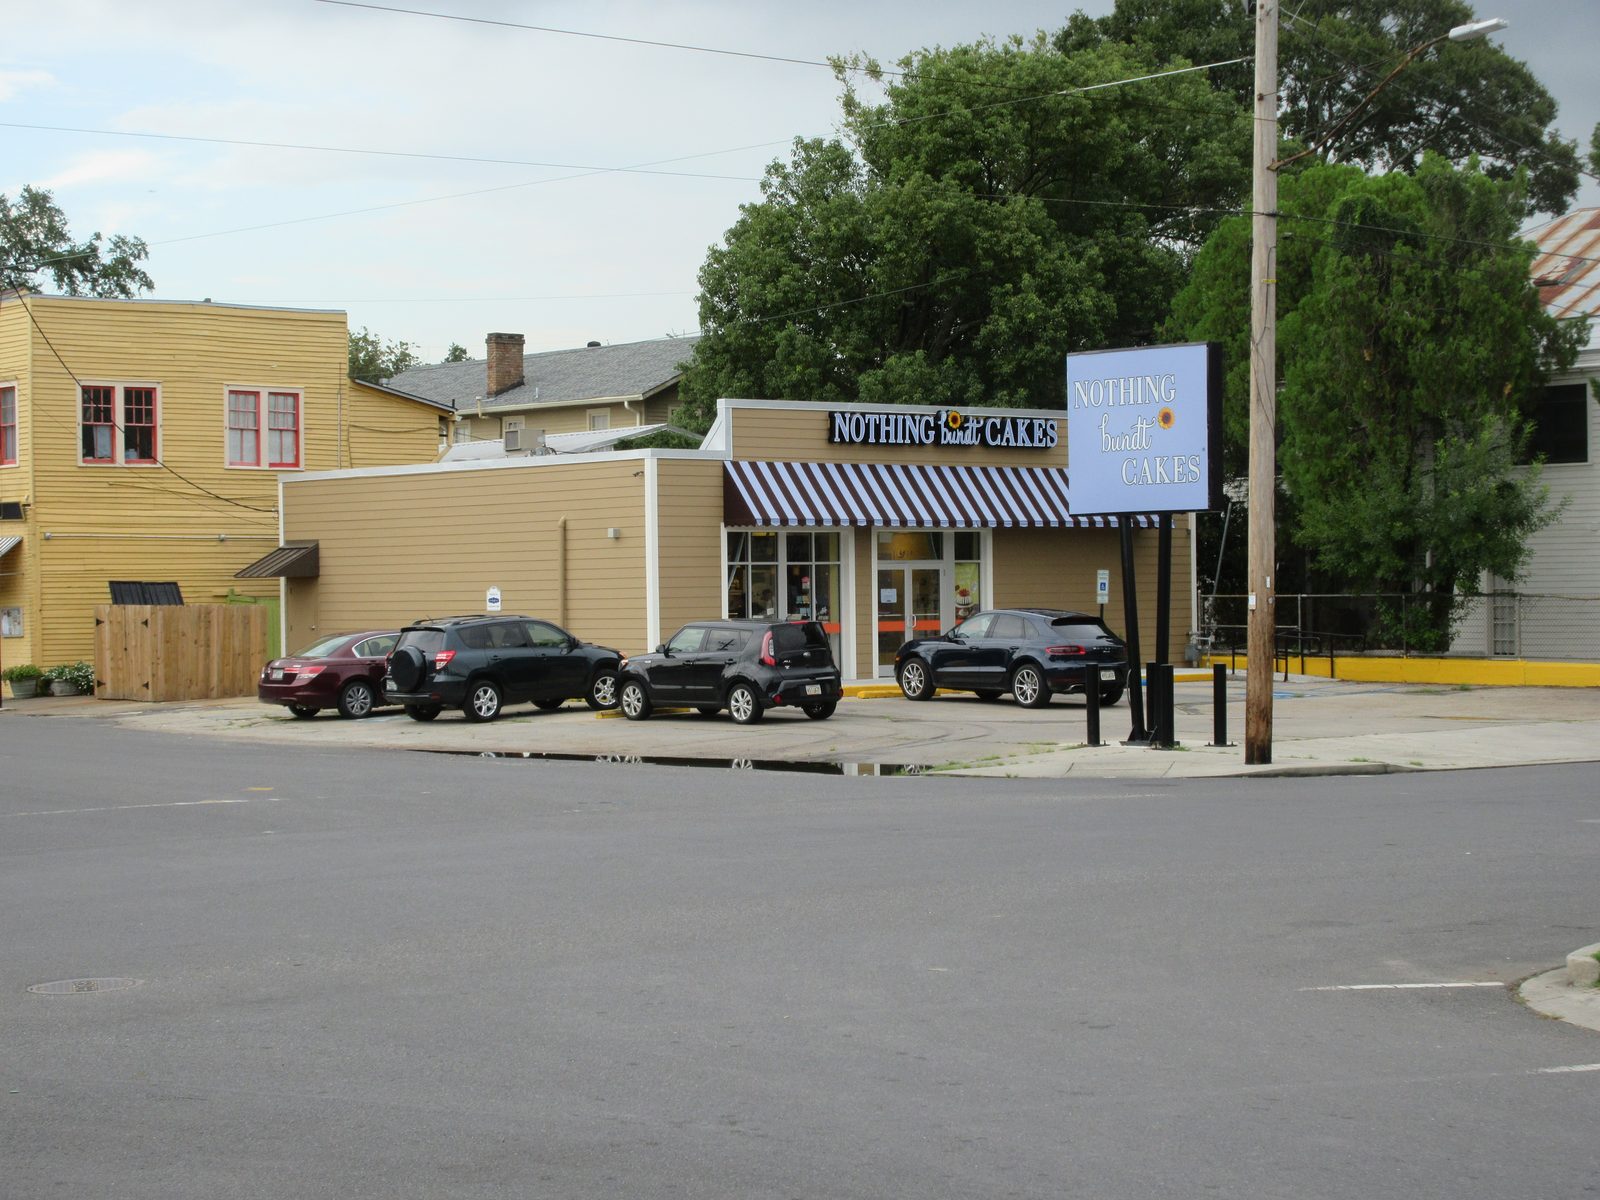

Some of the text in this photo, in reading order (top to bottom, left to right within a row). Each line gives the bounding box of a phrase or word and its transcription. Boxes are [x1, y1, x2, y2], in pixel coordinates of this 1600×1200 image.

[1074, 373, 1176, 409] NOTHING
[834, 410, 1058, 448] NOTHING bundt CAKES
[1098, 412, 1156, 453] bundt
[1121, 455, 1201, 486] CAKES
